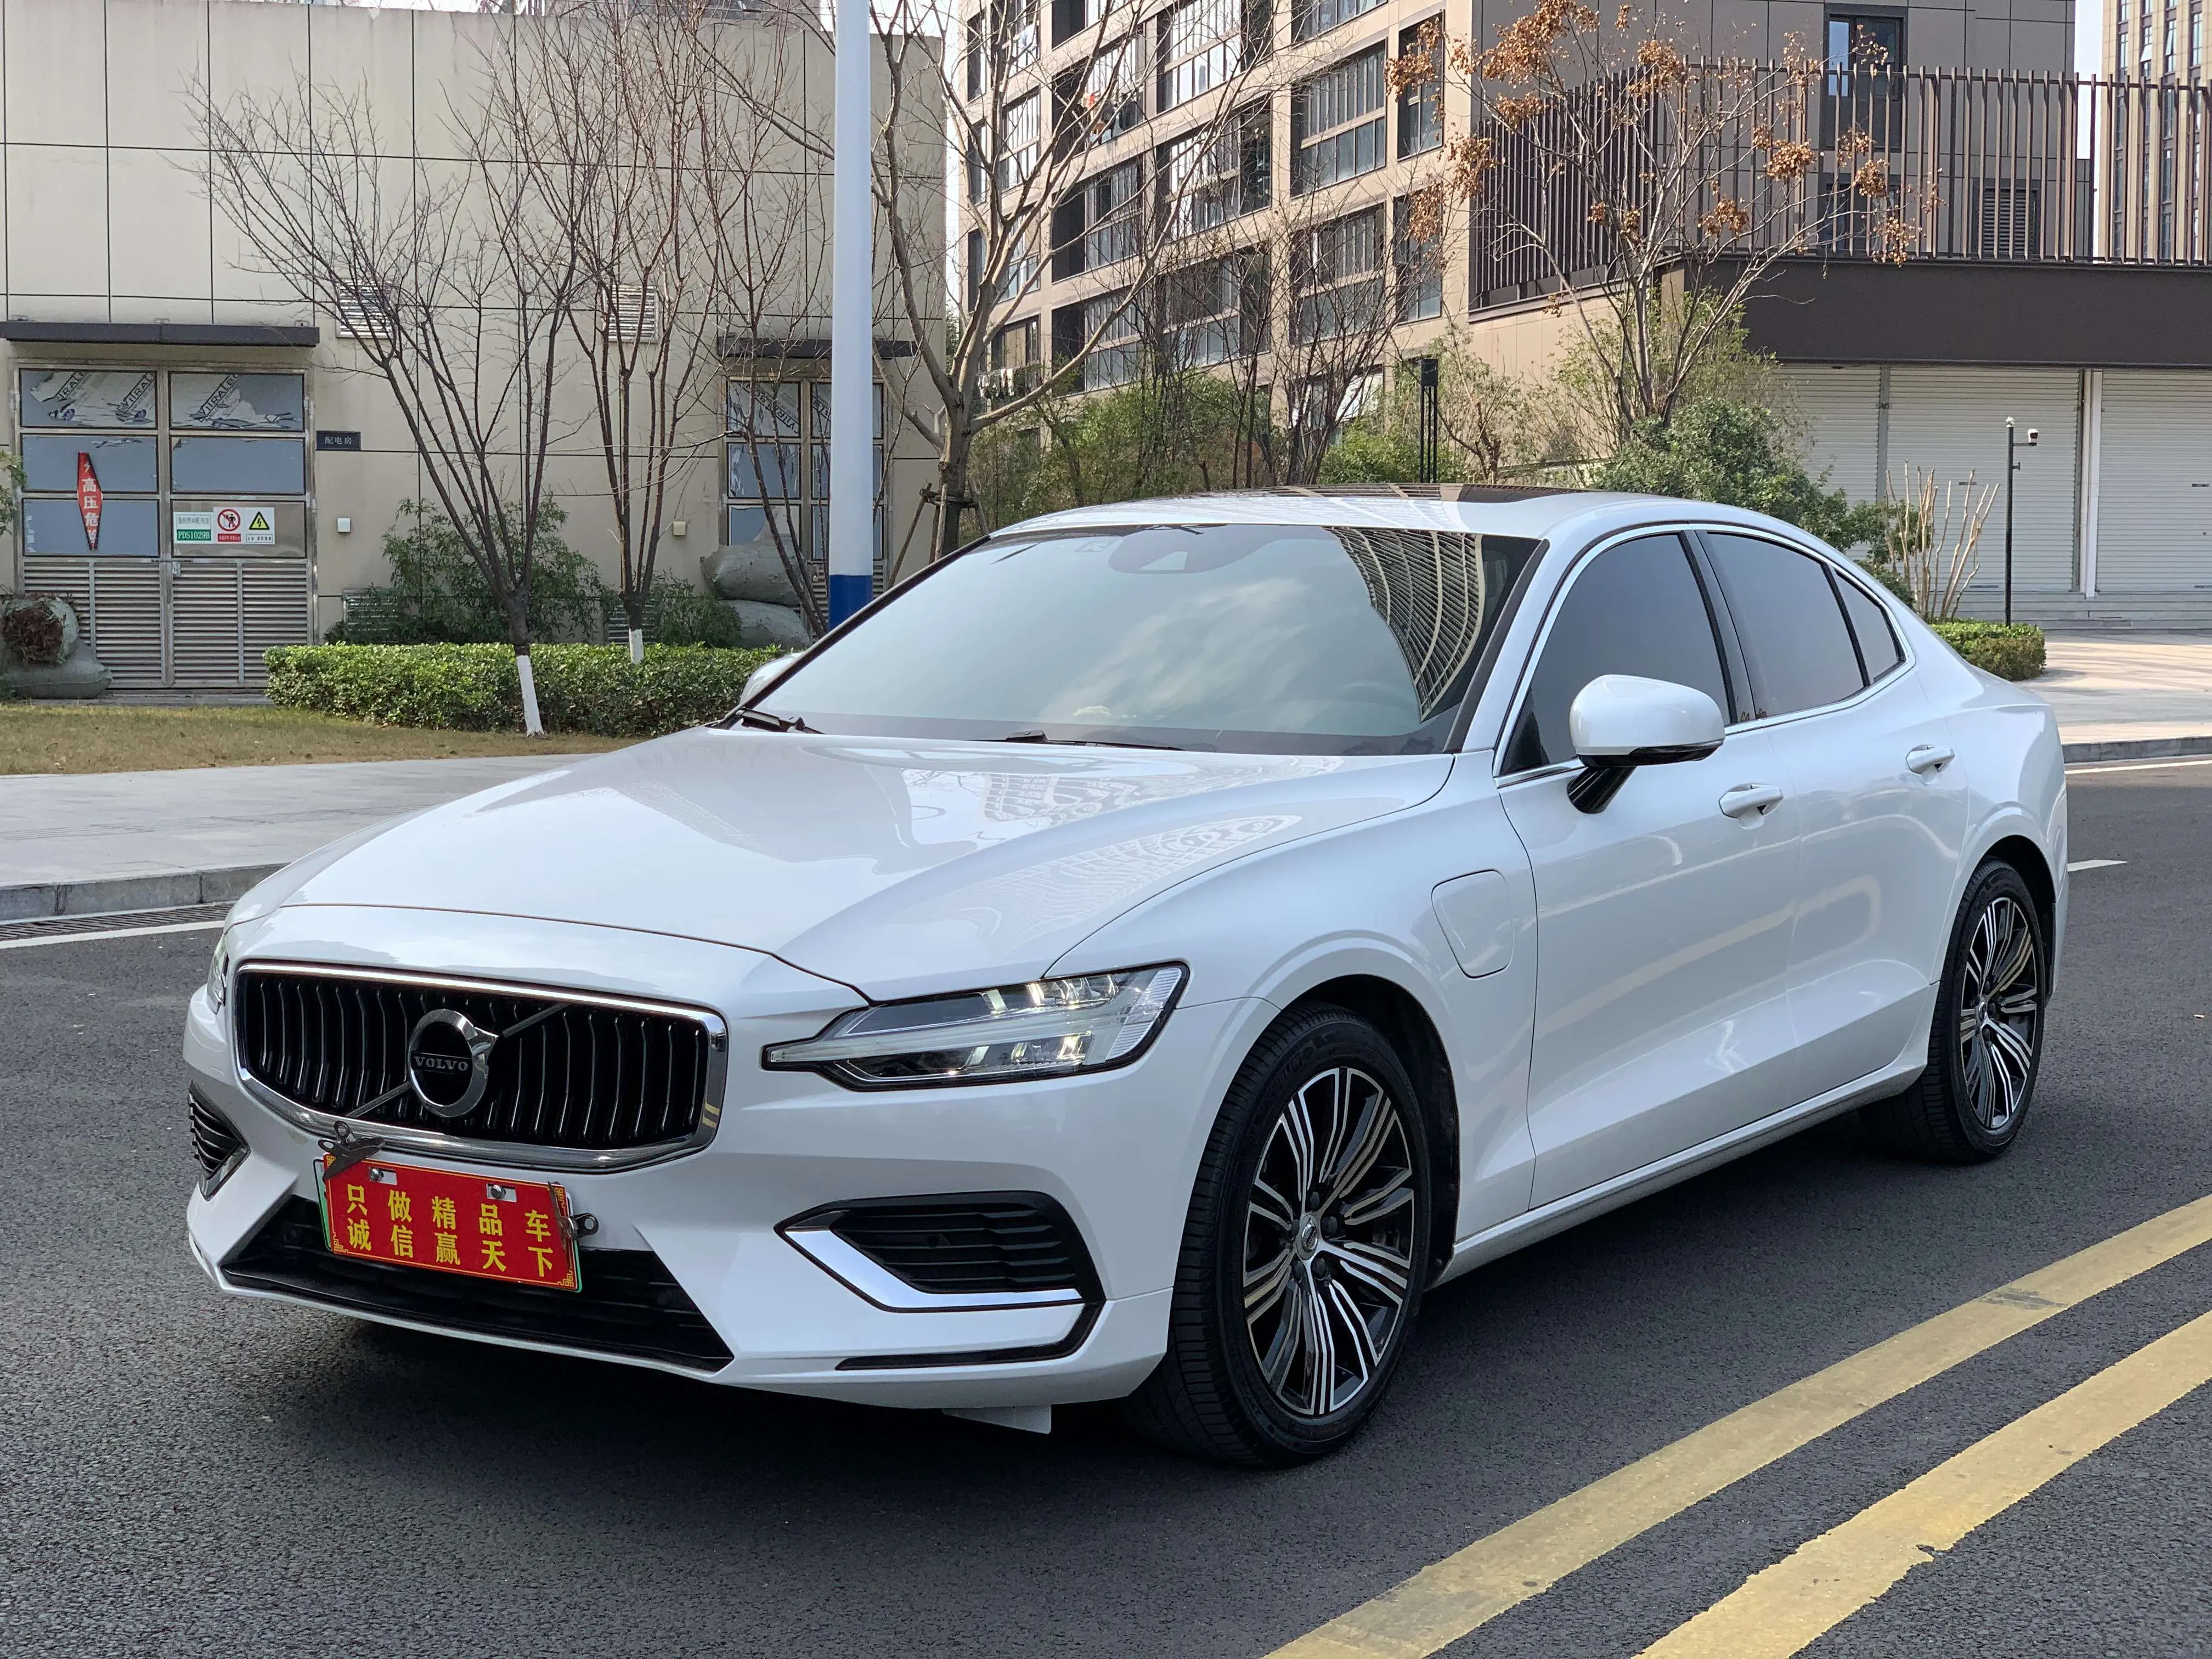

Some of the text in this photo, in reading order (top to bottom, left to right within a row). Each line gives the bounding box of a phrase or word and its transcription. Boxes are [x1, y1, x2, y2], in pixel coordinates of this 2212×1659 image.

[324, 436, 352, 445] 配电房
[178, 531, 210, 539] PDS1029B
[414, 1056, 469, 1071] VOLVO
[346, 1183, 551, 1243] 只做精品车
[347, 1218, 554, 1277] 诚信赢天下
